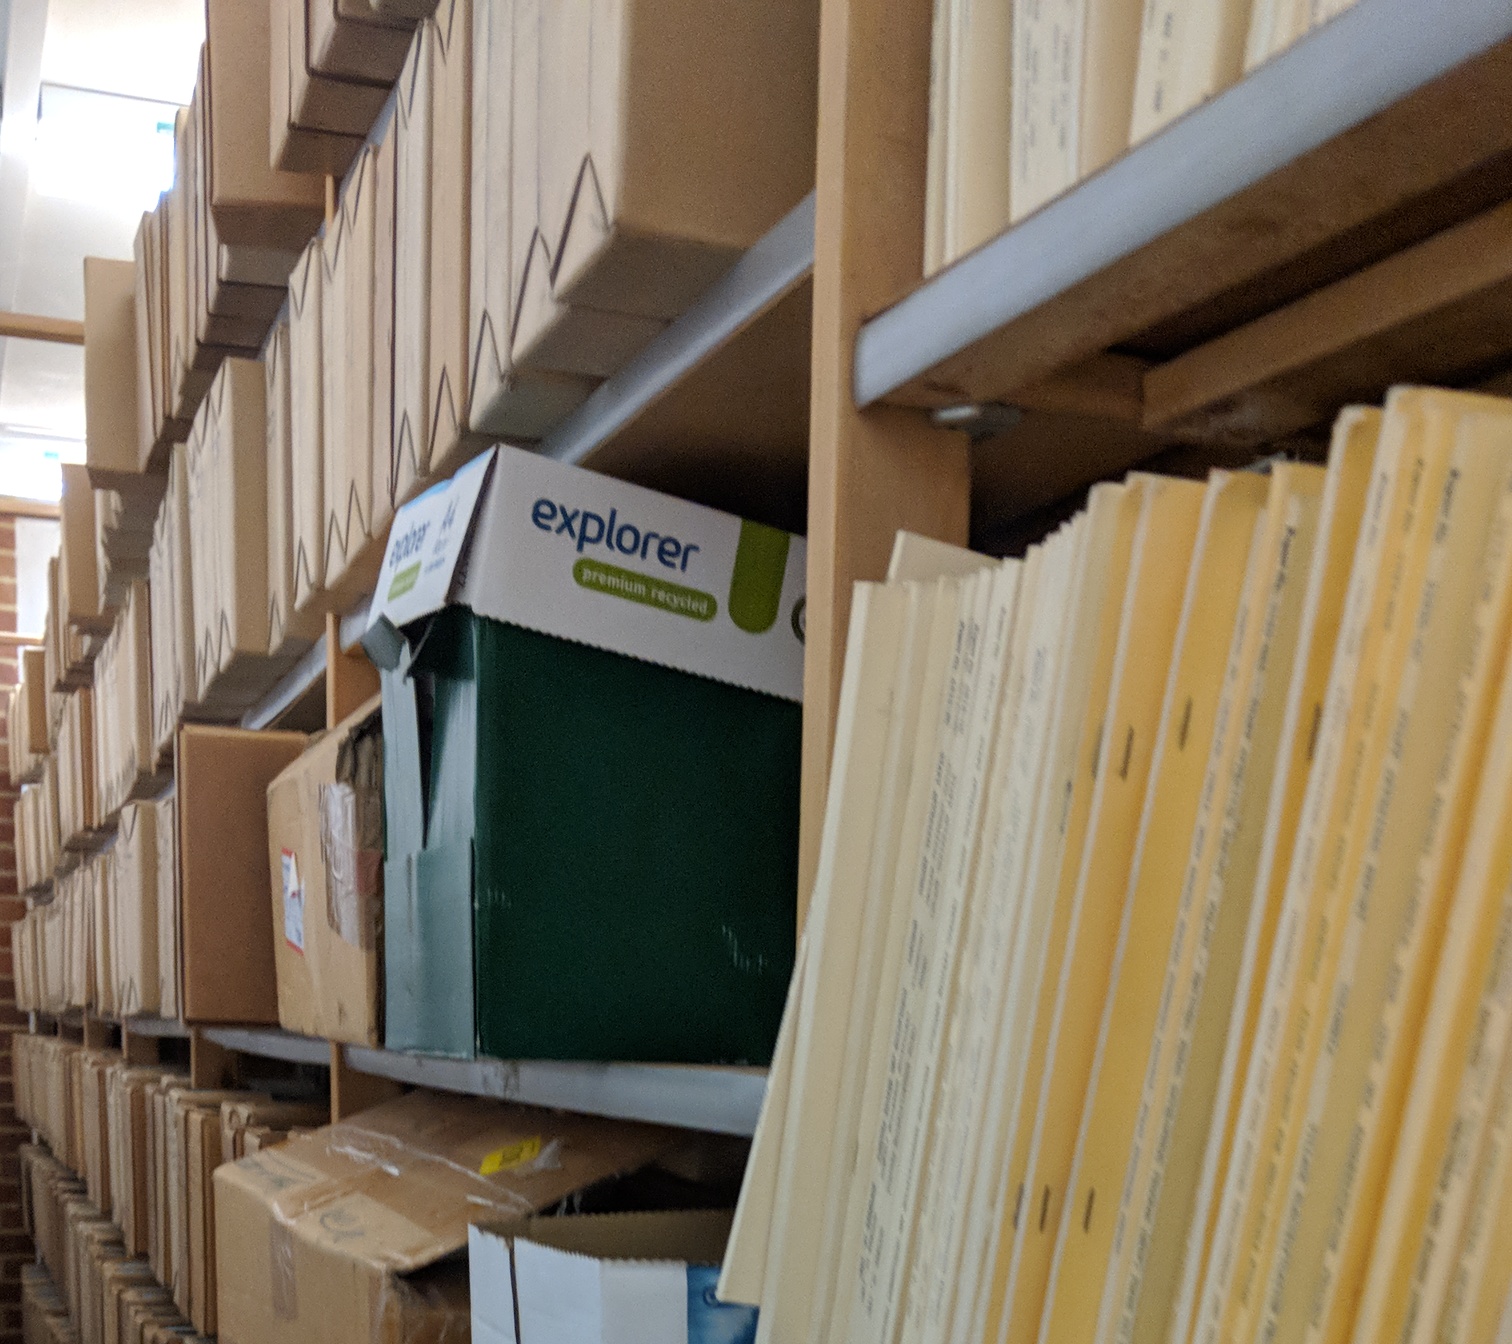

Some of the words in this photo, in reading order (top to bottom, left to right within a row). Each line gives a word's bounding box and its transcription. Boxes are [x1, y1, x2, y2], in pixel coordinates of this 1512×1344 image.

[531, 497, 700, 574] explorer
[582, 567, 647, 598] premium
[651, 587, 709, 615] recycled
